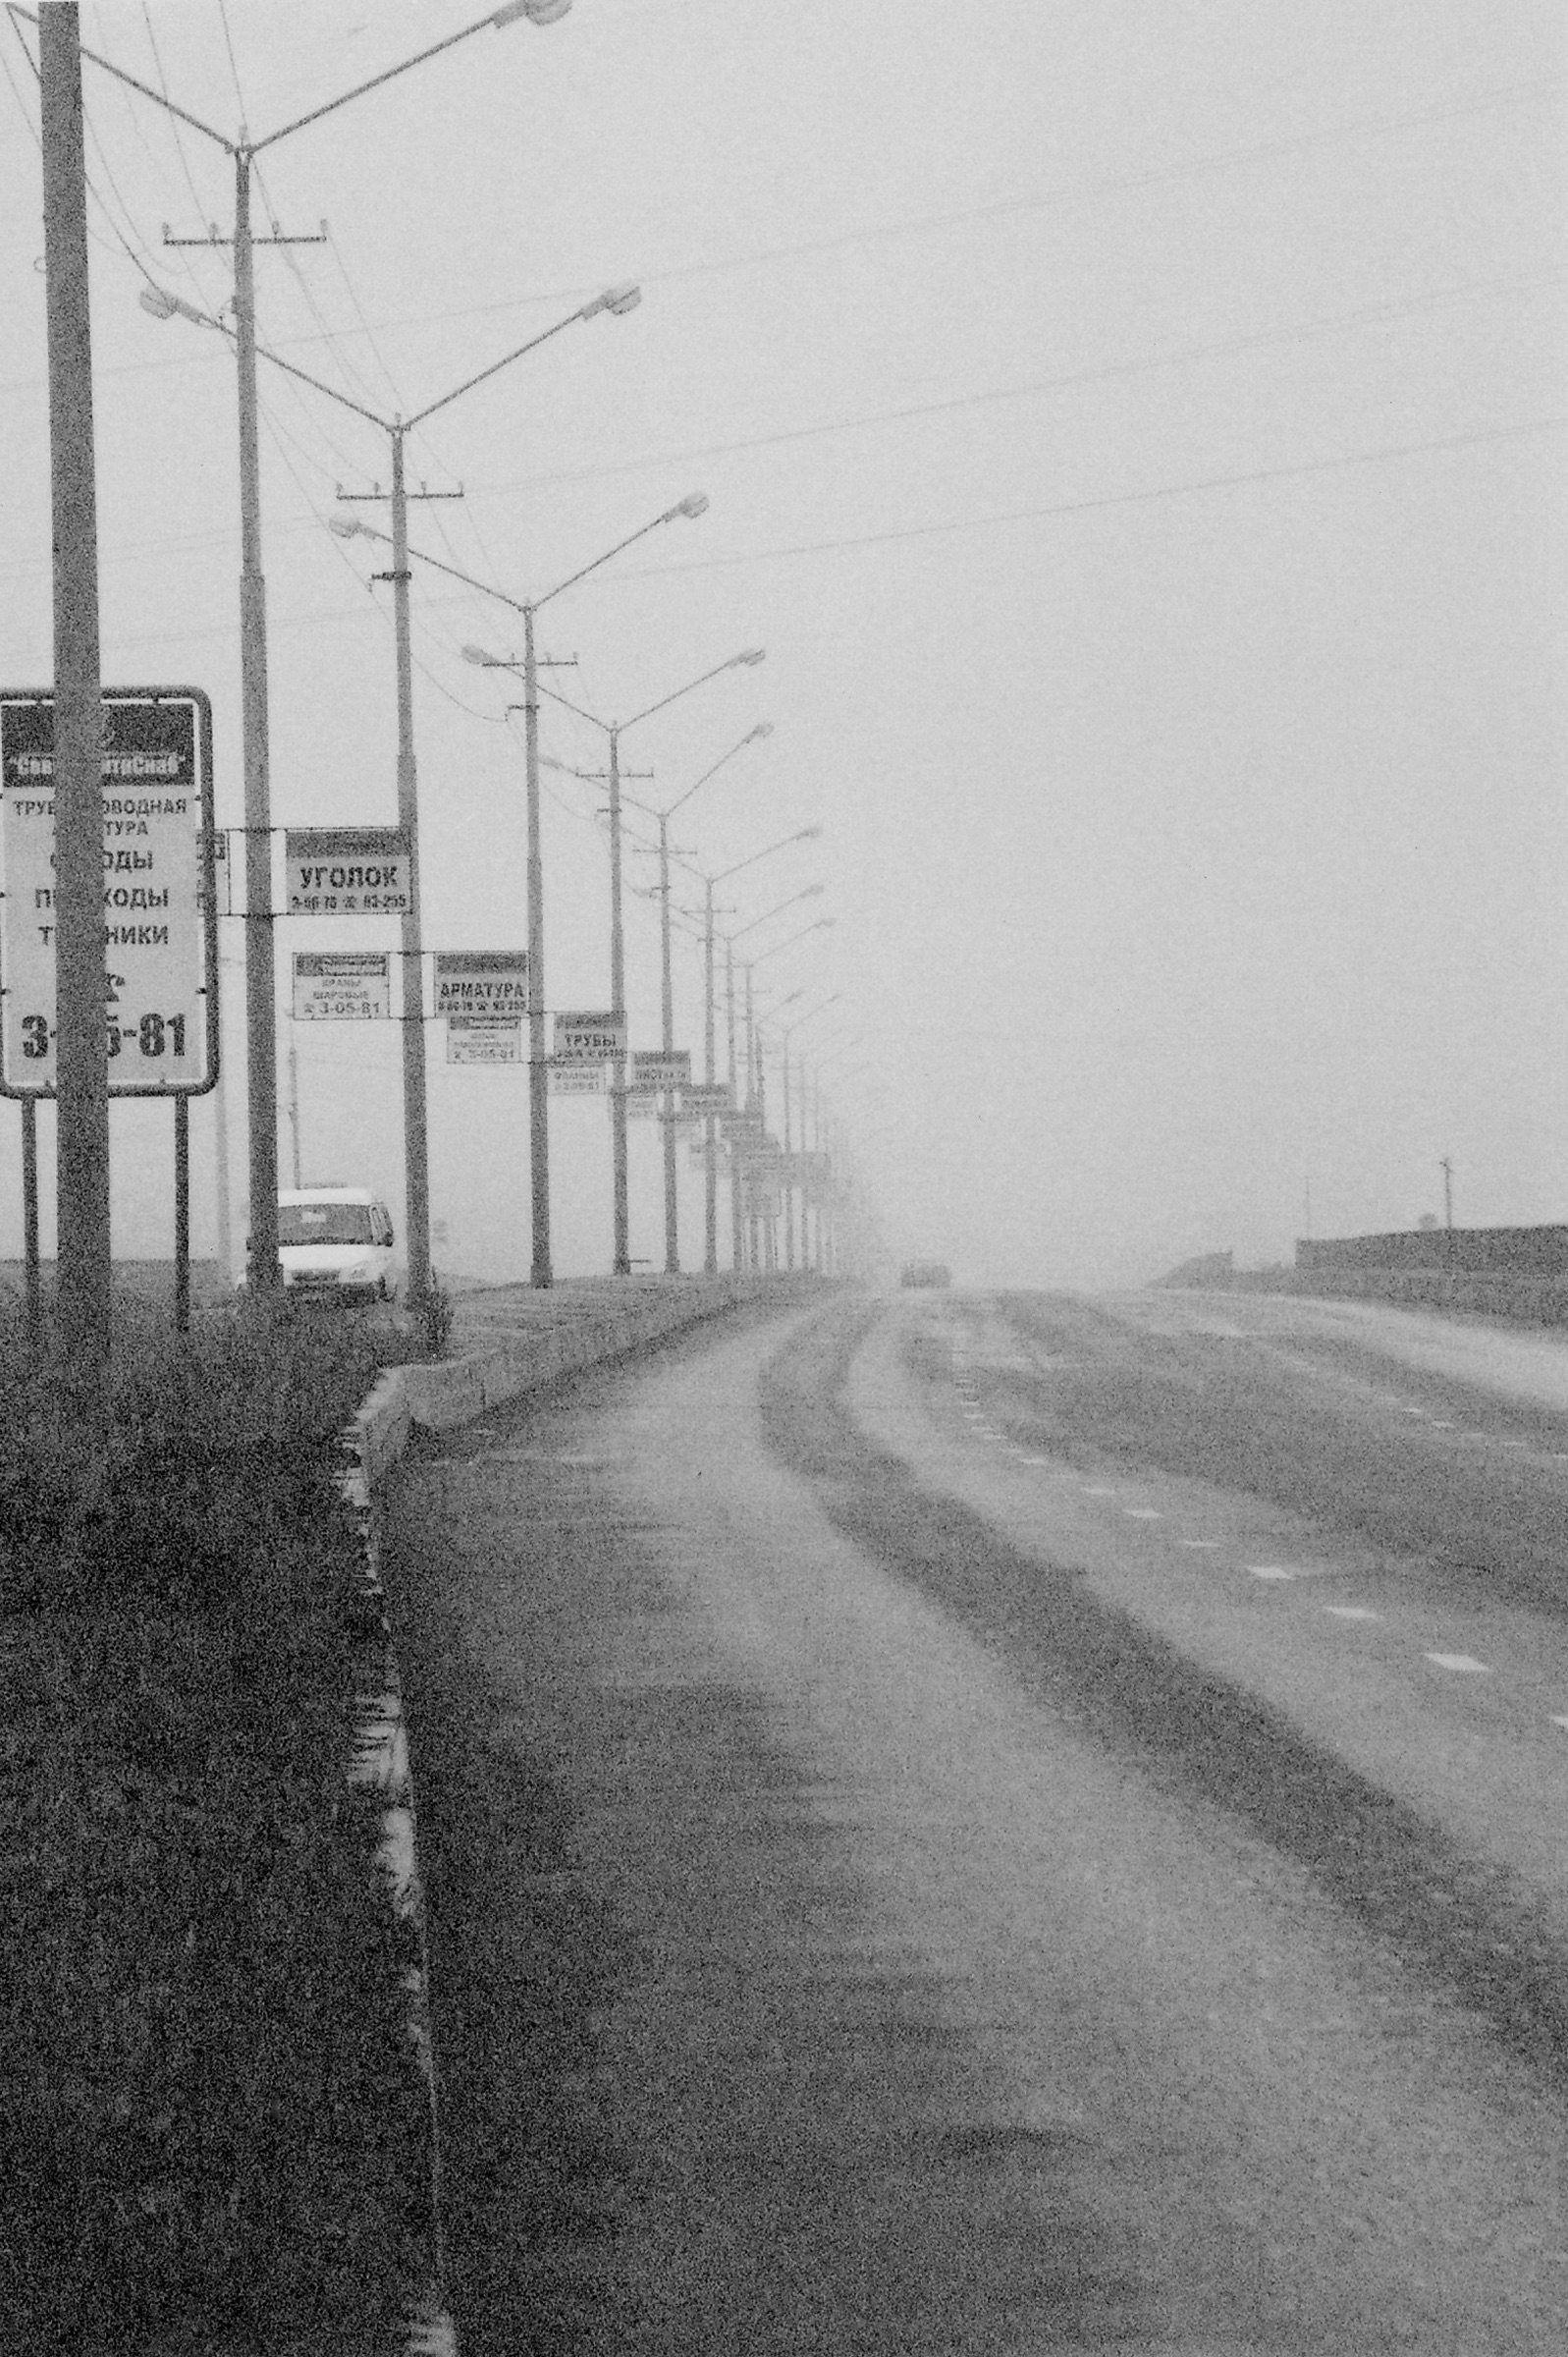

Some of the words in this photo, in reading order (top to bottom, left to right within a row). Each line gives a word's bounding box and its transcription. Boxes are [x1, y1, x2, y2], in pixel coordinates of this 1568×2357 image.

[13, 798, 187, 817] ТРУБОВОДНАЯ
[50, 850, 153, 873] ОДЫ
[299, 865, 398, 889] УГОЛОК
[34, 888, 168, 910] ПХОДЫ
[37, 925, 168, 946] ТНИКИ
[440, 982, 524, 999] АРМАТУРА
[319, 1002, 380, 1014] 3-05-81
[22, 1013, 187, 1059] 3-5-81
[565, 1033, 617, 1047] ТРУБЫ
